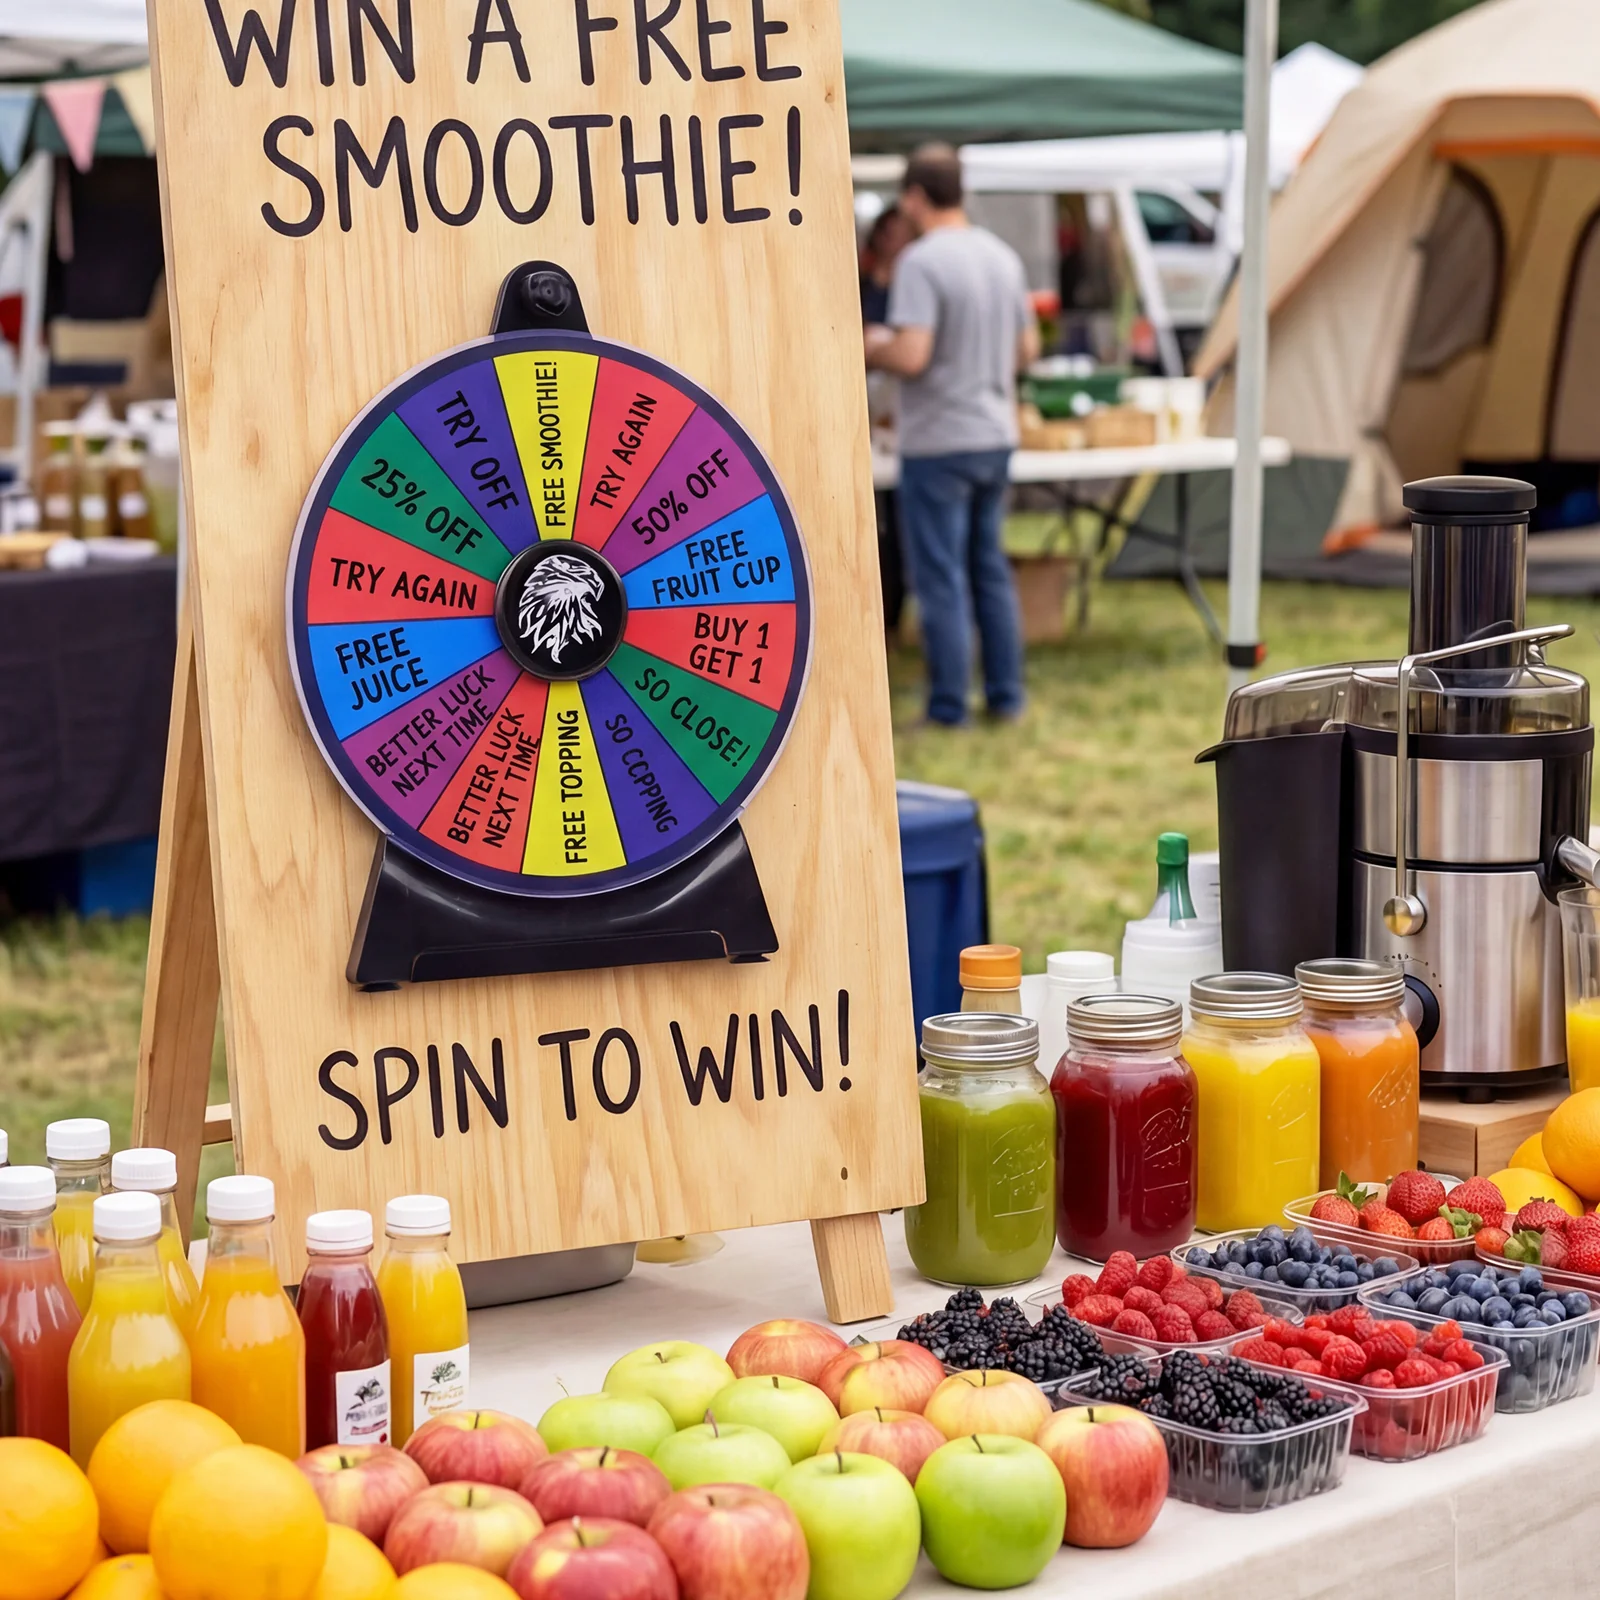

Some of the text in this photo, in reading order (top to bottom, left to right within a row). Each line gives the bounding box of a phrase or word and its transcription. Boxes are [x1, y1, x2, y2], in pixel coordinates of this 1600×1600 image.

[207, 0, 802, 87] WIN A FREE
[261, 106, 802, 237] SMOOTHIE!
[436, 390, 519, 511] TRY OFF
[534, 361, 566, 527] FREE SMOOTHIE!
[590, 392, 658, 509] TRY AGAIN
[360, 458, 483, 555] 25% OFF
[631, 448, 730, 545] 50% OFF
[330, 557, 477, 611] TRY AGAIN
[652, 556, 781, 604] FRUIT CUP
[685, 529, 748, 569] FREE
[334, 627, 411, 675] FREE
[689, 644, 763, 684] GET 1
[694, 612, 770, 649] BUY 1
[351, 657, 429, 711] JUICE
[365, 664, 496, 777] BETTER LUCK
[634, 667, 751, 767] SO CLOSE!
[391, 698, 494, 798] NEXT TIME
[446, 707, 525, 844] BETTER LUCK
[482, 734, 542, 848] NEXT TIME
[557, 710, 588, 864] FREE TOPPING
[605, 713, 678, 833] SO CCPPING
[318, 989, 852, 1150] SPIN TO WIN!
